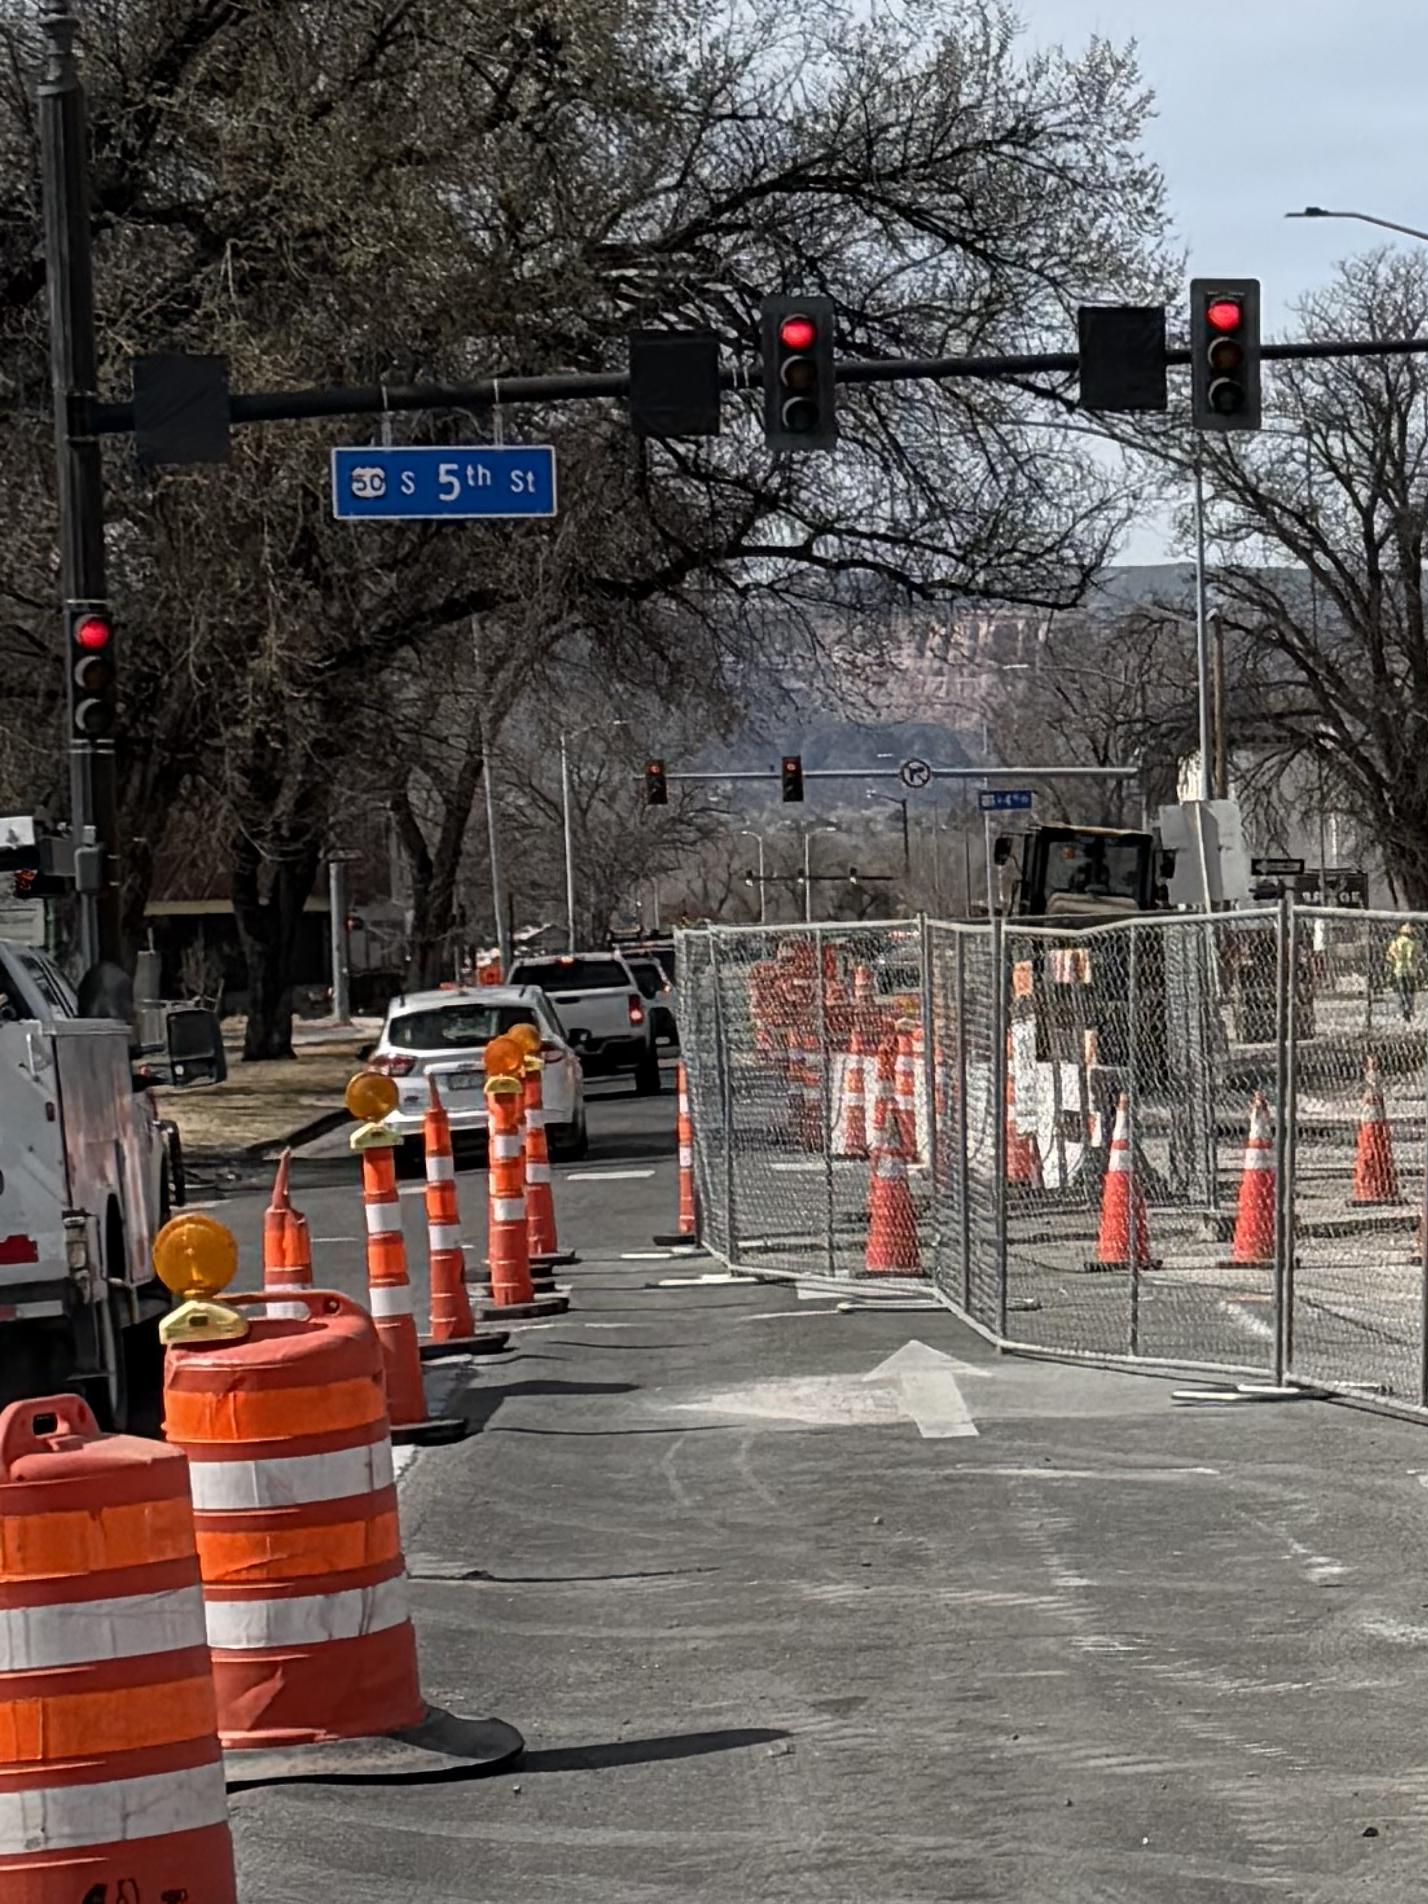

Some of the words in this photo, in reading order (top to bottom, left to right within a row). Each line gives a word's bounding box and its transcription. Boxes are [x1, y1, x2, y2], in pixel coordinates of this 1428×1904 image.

[400, 470, 416, 495] S
[438, 462, 492, 502] 5th
[510, 469, 536, 493] St
